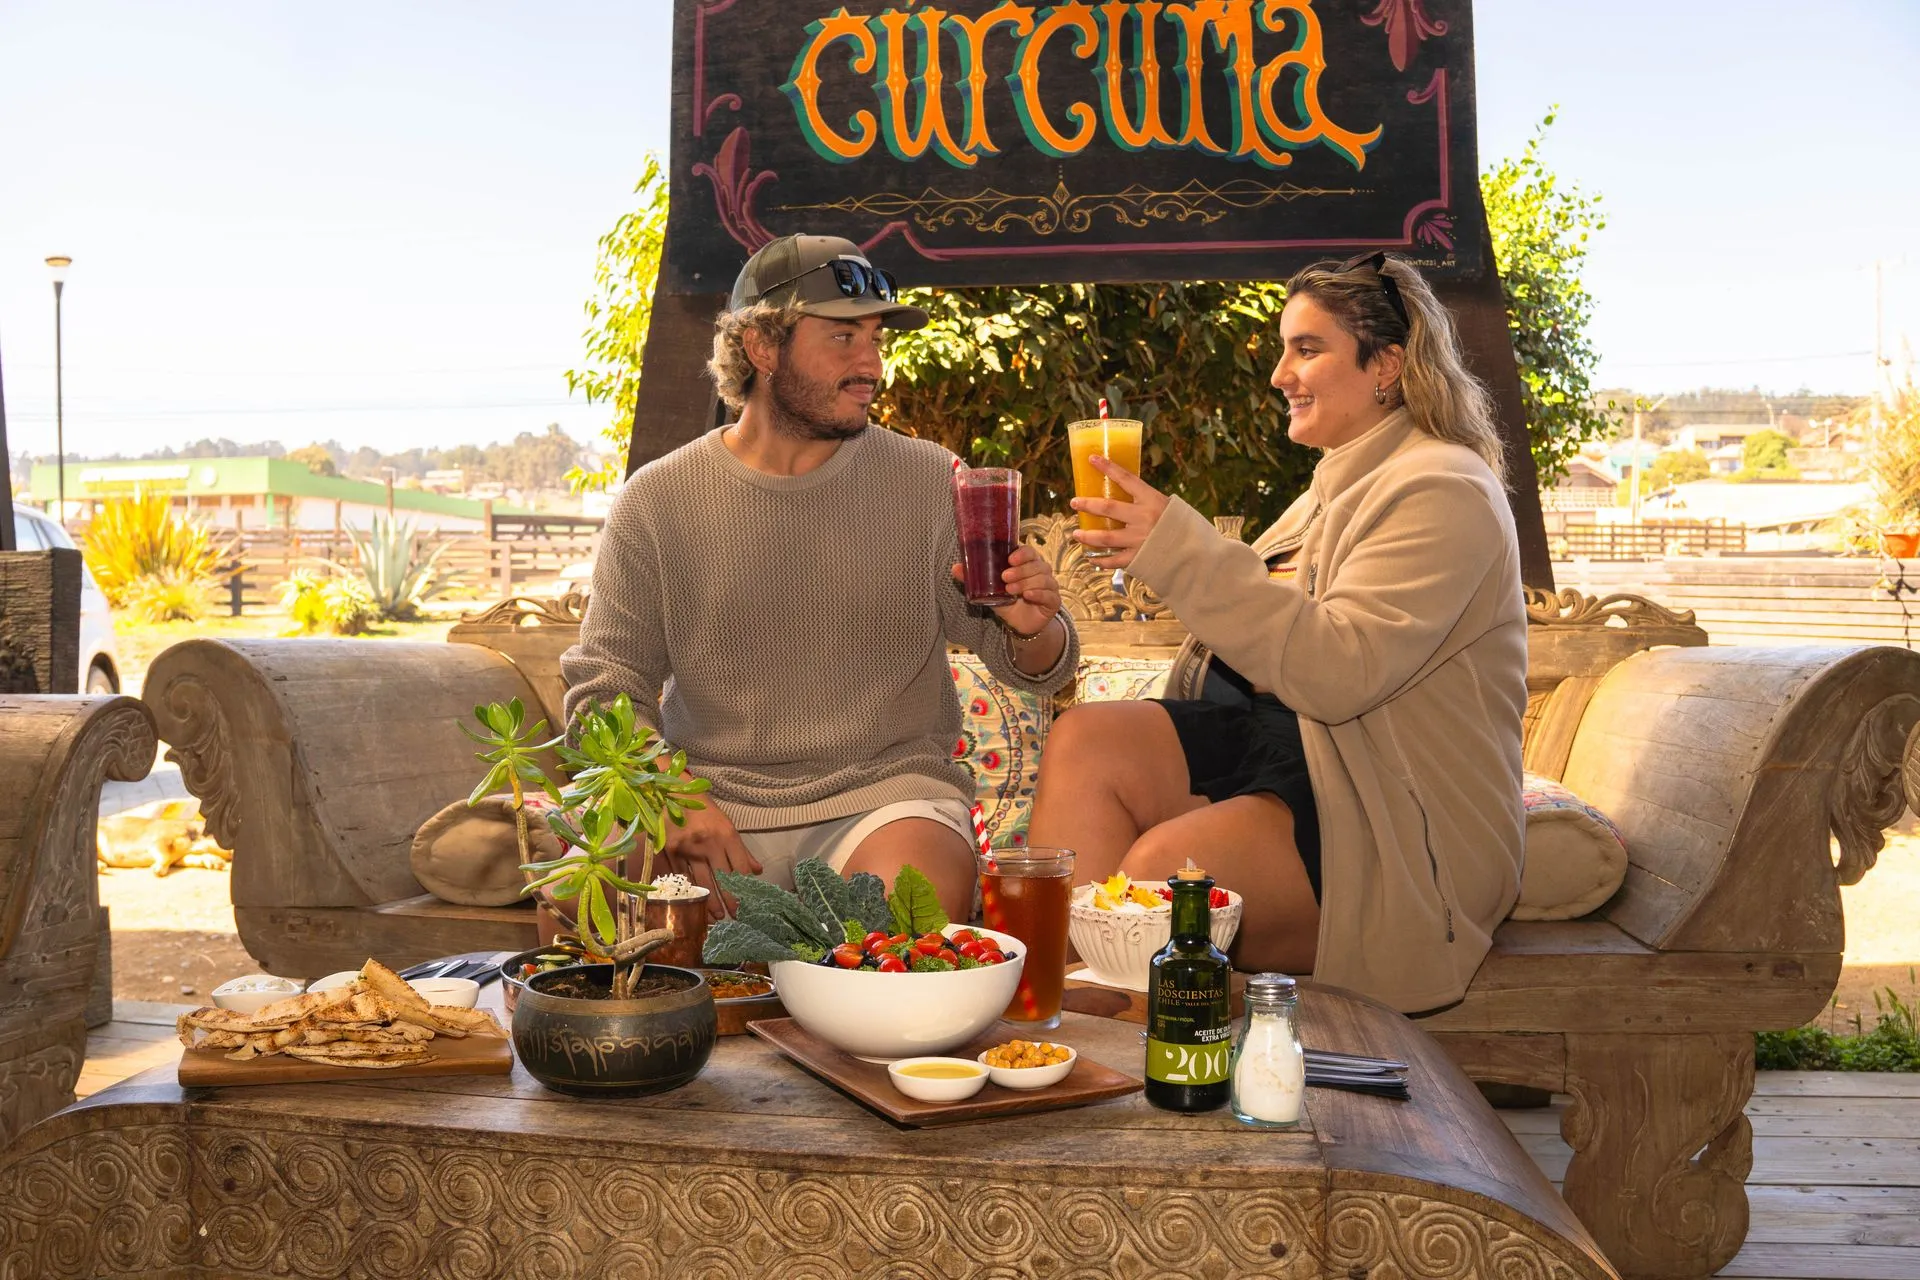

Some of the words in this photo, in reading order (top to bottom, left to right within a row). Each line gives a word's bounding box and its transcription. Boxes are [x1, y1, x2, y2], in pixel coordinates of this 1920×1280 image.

[1158, 979, 1175, 988] LAS
[1158, 987, 1224, 1000] DOSCIENTAS
[1158, 997, 1180, 1006] CHILE
[1194, 1029, 1216, 1037] ACEITE
[1216, 1027, 1224, 1035] DE
[1201, 1034, 1220, 1043] EXTRA
[1165, 1046, 1229, 1082] 200
